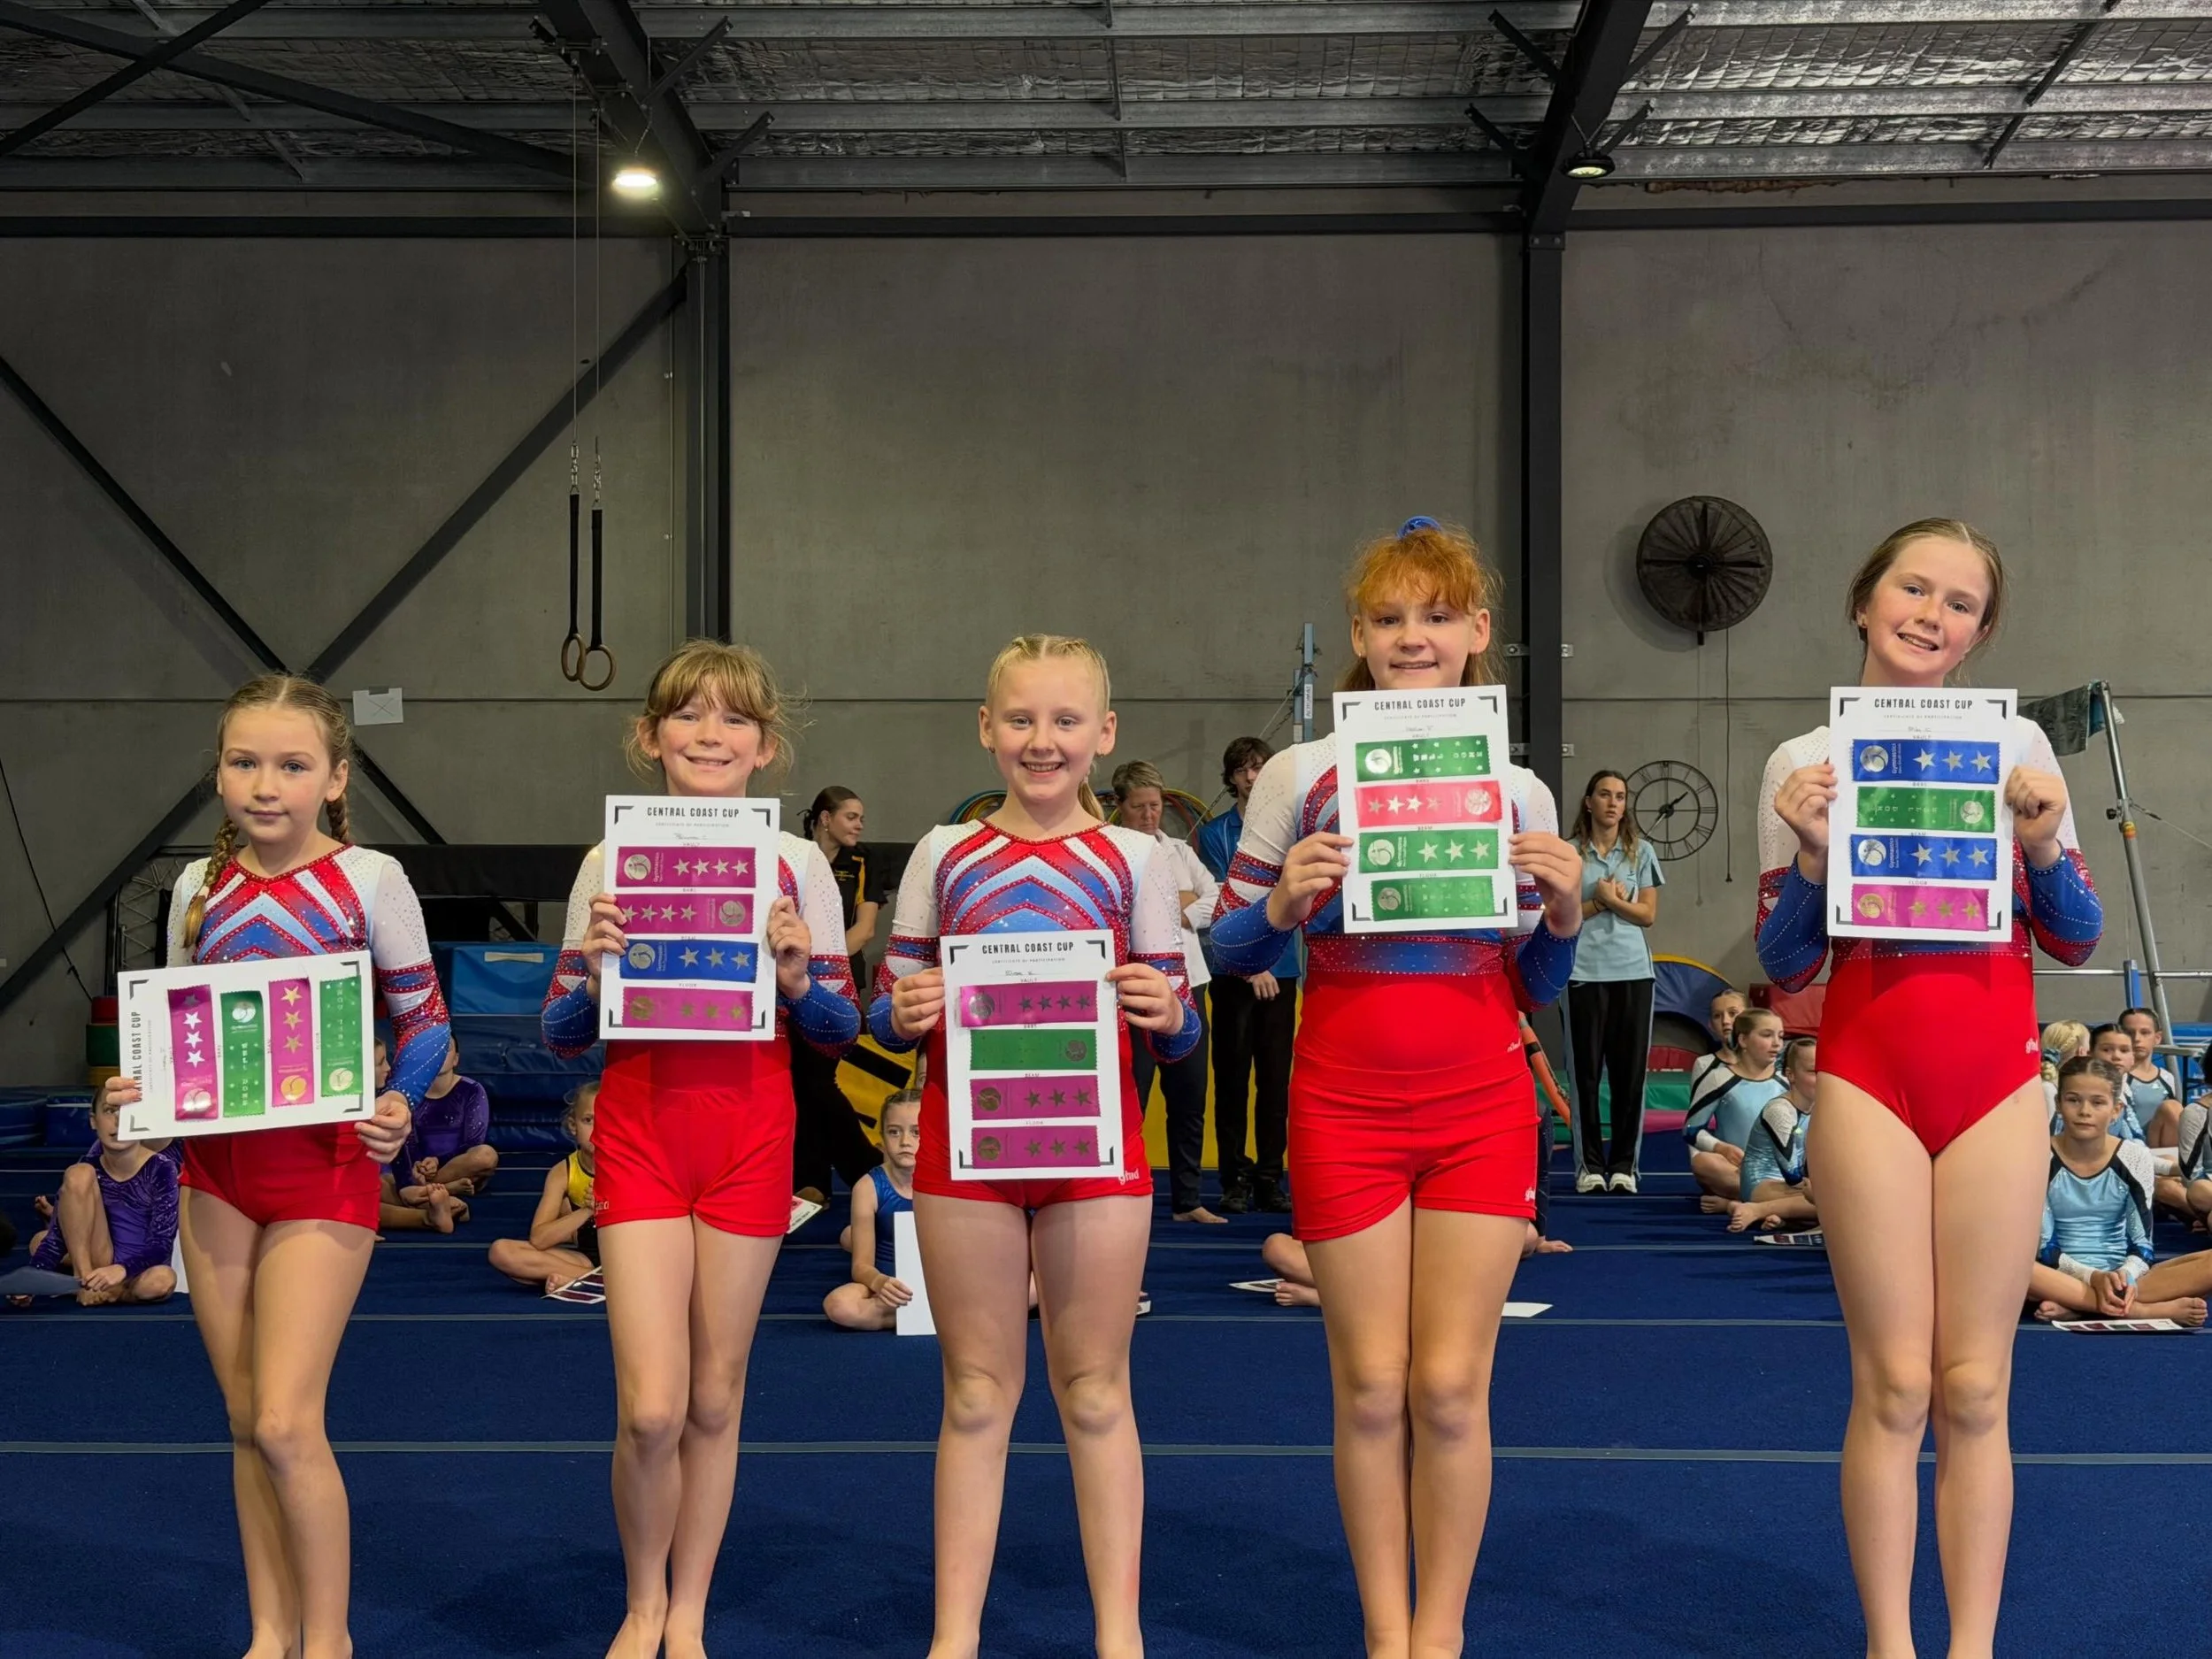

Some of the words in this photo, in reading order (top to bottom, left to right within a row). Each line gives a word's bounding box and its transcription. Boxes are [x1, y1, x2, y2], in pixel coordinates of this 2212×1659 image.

[1374, 700, 1413, 710] CENTRAL
[1417, 699, 1445, 709] COAST
[1448, 698, 1466, 708] CUP
[1874, 698, 1916, 709] CENTRAL
[1920, 699, 1950, 709] COAST
[1955, 700, 1973, 710] CUP
[647, 807, 686, 818] CENTRAL
[689, 807, 718, 818] COAST
[722, 808, 740, 818] CUP
[982, 943, 1021, 955] CENTRAL
[1025, 942, 1053, 953] COAST
[1056, 941, 1074, 951] CUP
[131, 1011, 142, 1028] CUP
[132, 1033, 142, 1060] COAST
